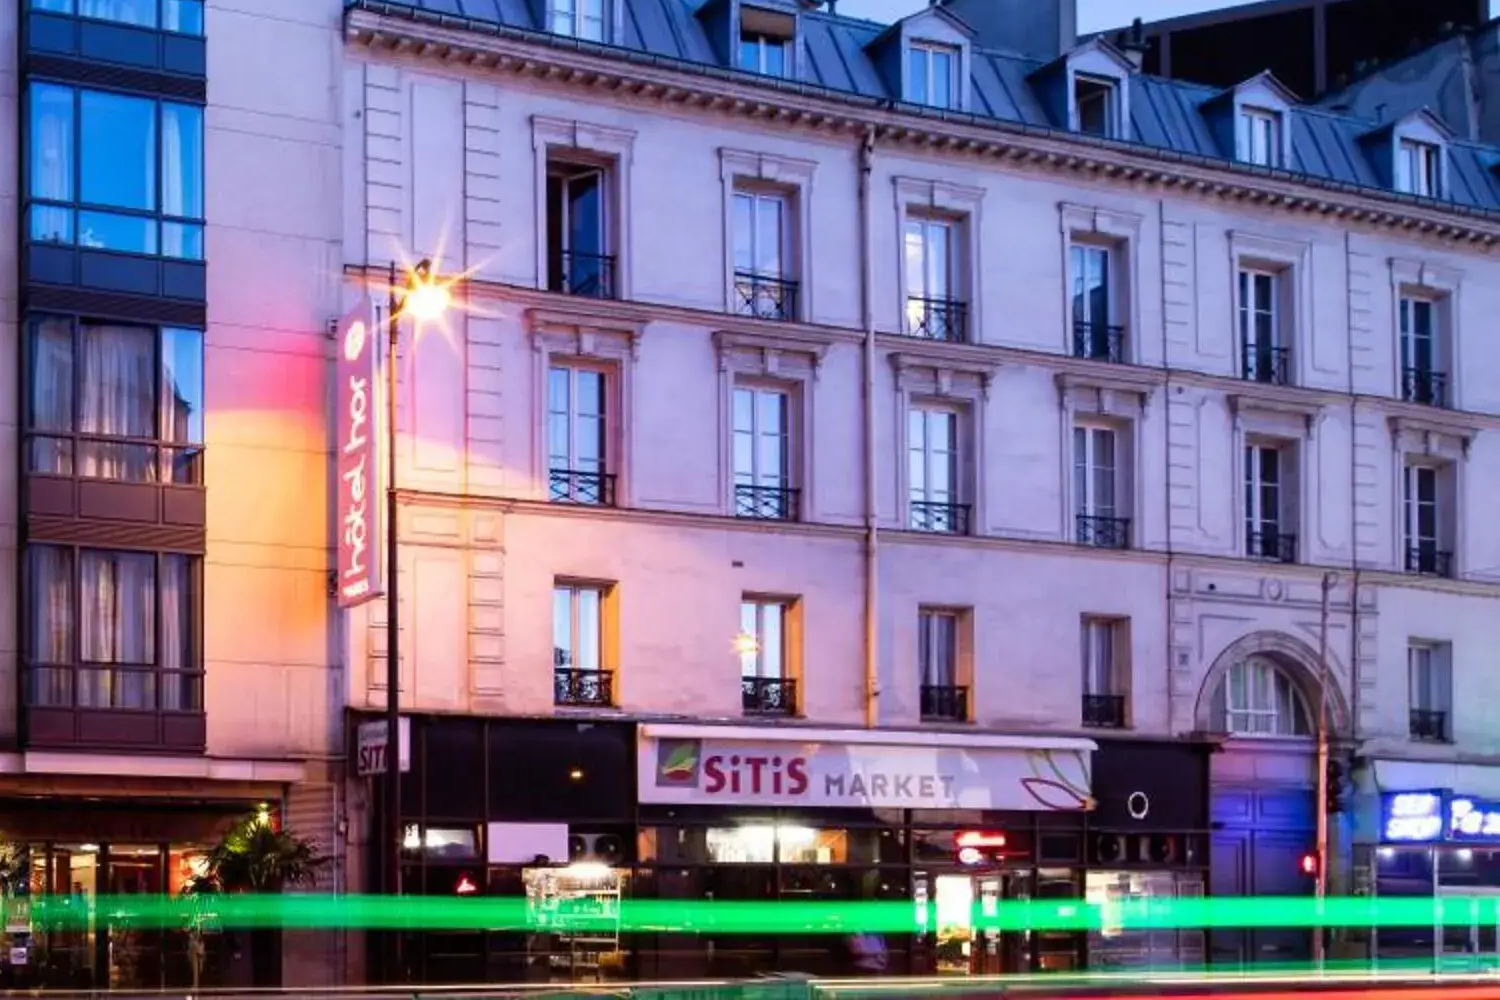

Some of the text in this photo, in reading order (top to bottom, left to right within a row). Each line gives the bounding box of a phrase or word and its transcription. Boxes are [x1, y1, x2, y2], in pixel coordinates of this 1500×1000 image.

[344, 376, 367, 578] hôtel hor
[825, 773, 955, 798] MARKET
